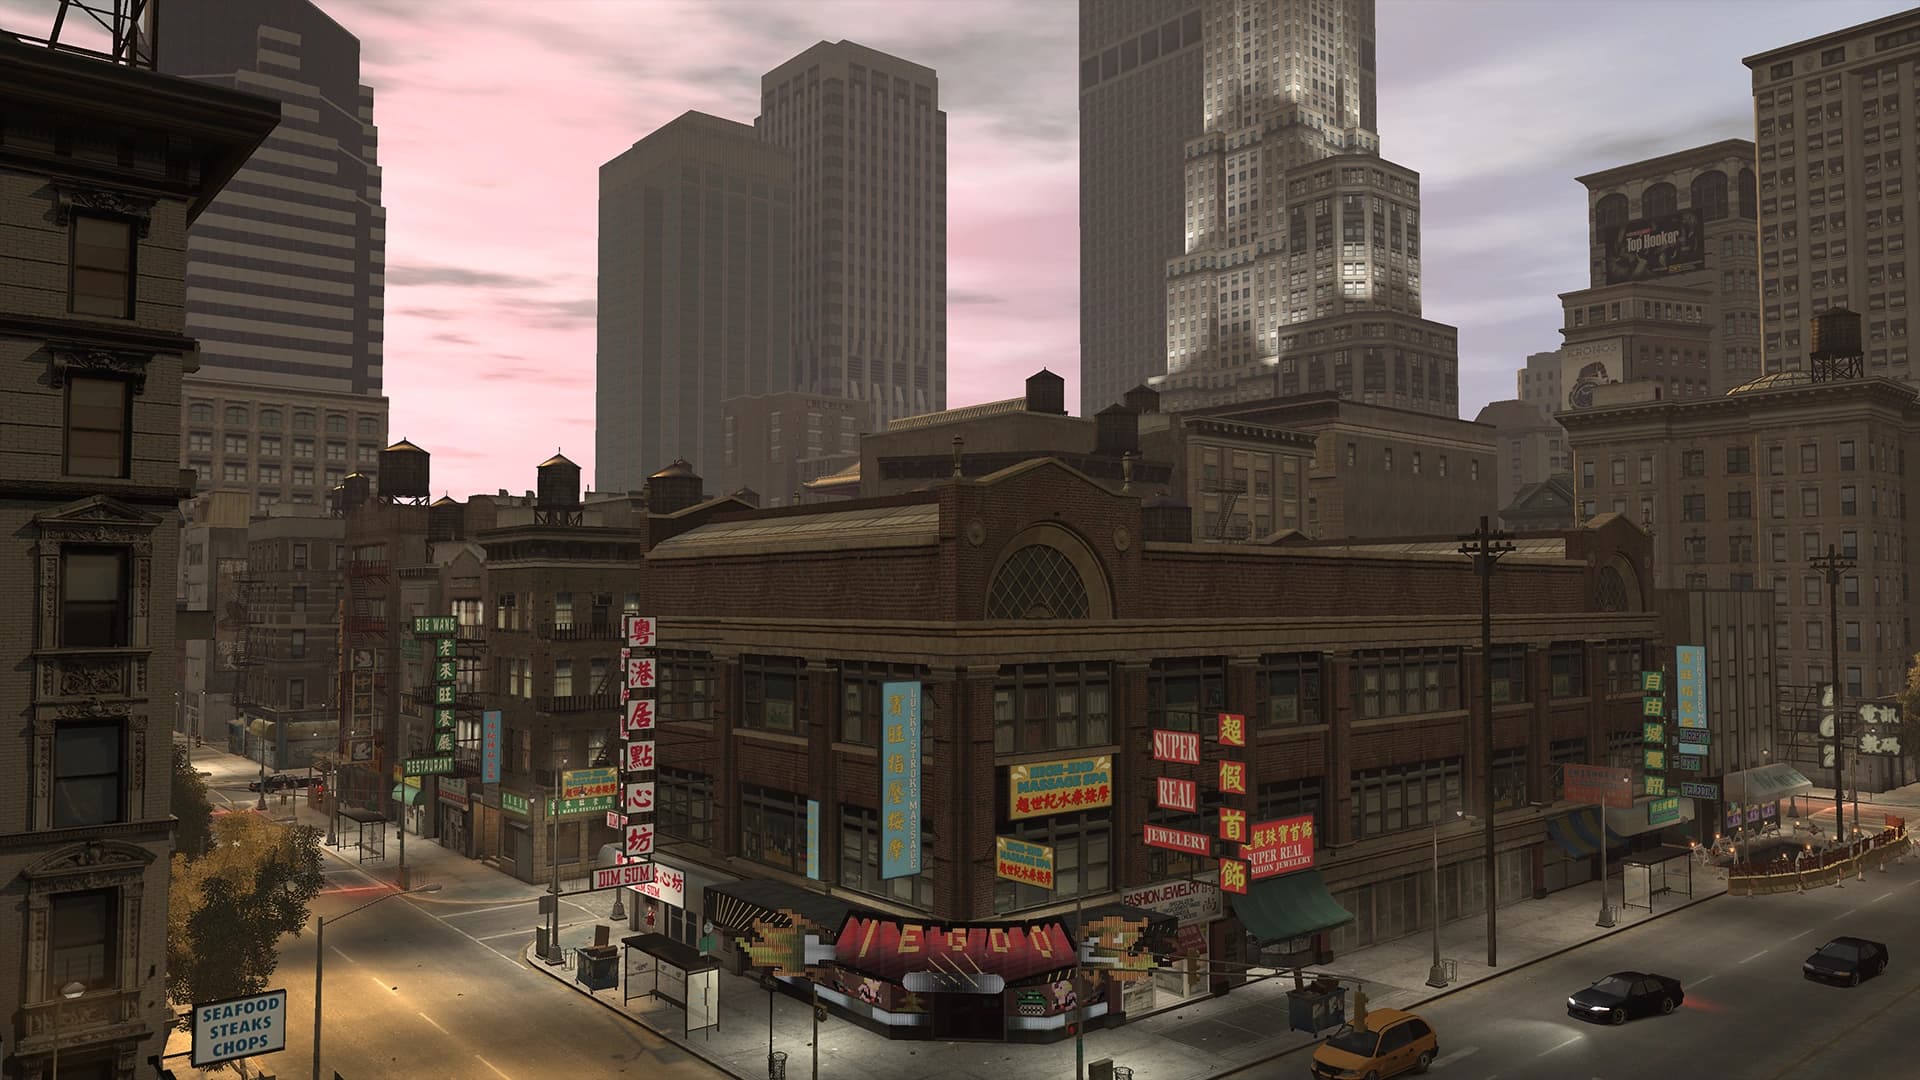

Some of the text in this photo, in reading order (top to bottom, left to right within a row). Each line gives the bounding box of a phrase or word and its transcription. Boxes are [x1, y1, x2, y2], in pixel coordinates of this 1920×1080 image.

[1626, 236, 1643, 253] Top
[1643, 230, 1680, 250] Hooker
[416, 617, 456, 631] BIG WANG
[1155, 732, 1198, 761] SUPER
[406, 758, 453, 775] RESTAURANT
[1159, 780, 1194, 809] REAL
[1145, 826, 1206, 852] JEWELERY
[1247, 844, 1304, 867] SUPER REAL
[1275, 856, 1312, 873] JEWELERY
[598, 865, 650, 888] DIM SUM
[1123, 881, 1200, 907] FASHION JEWELRY
